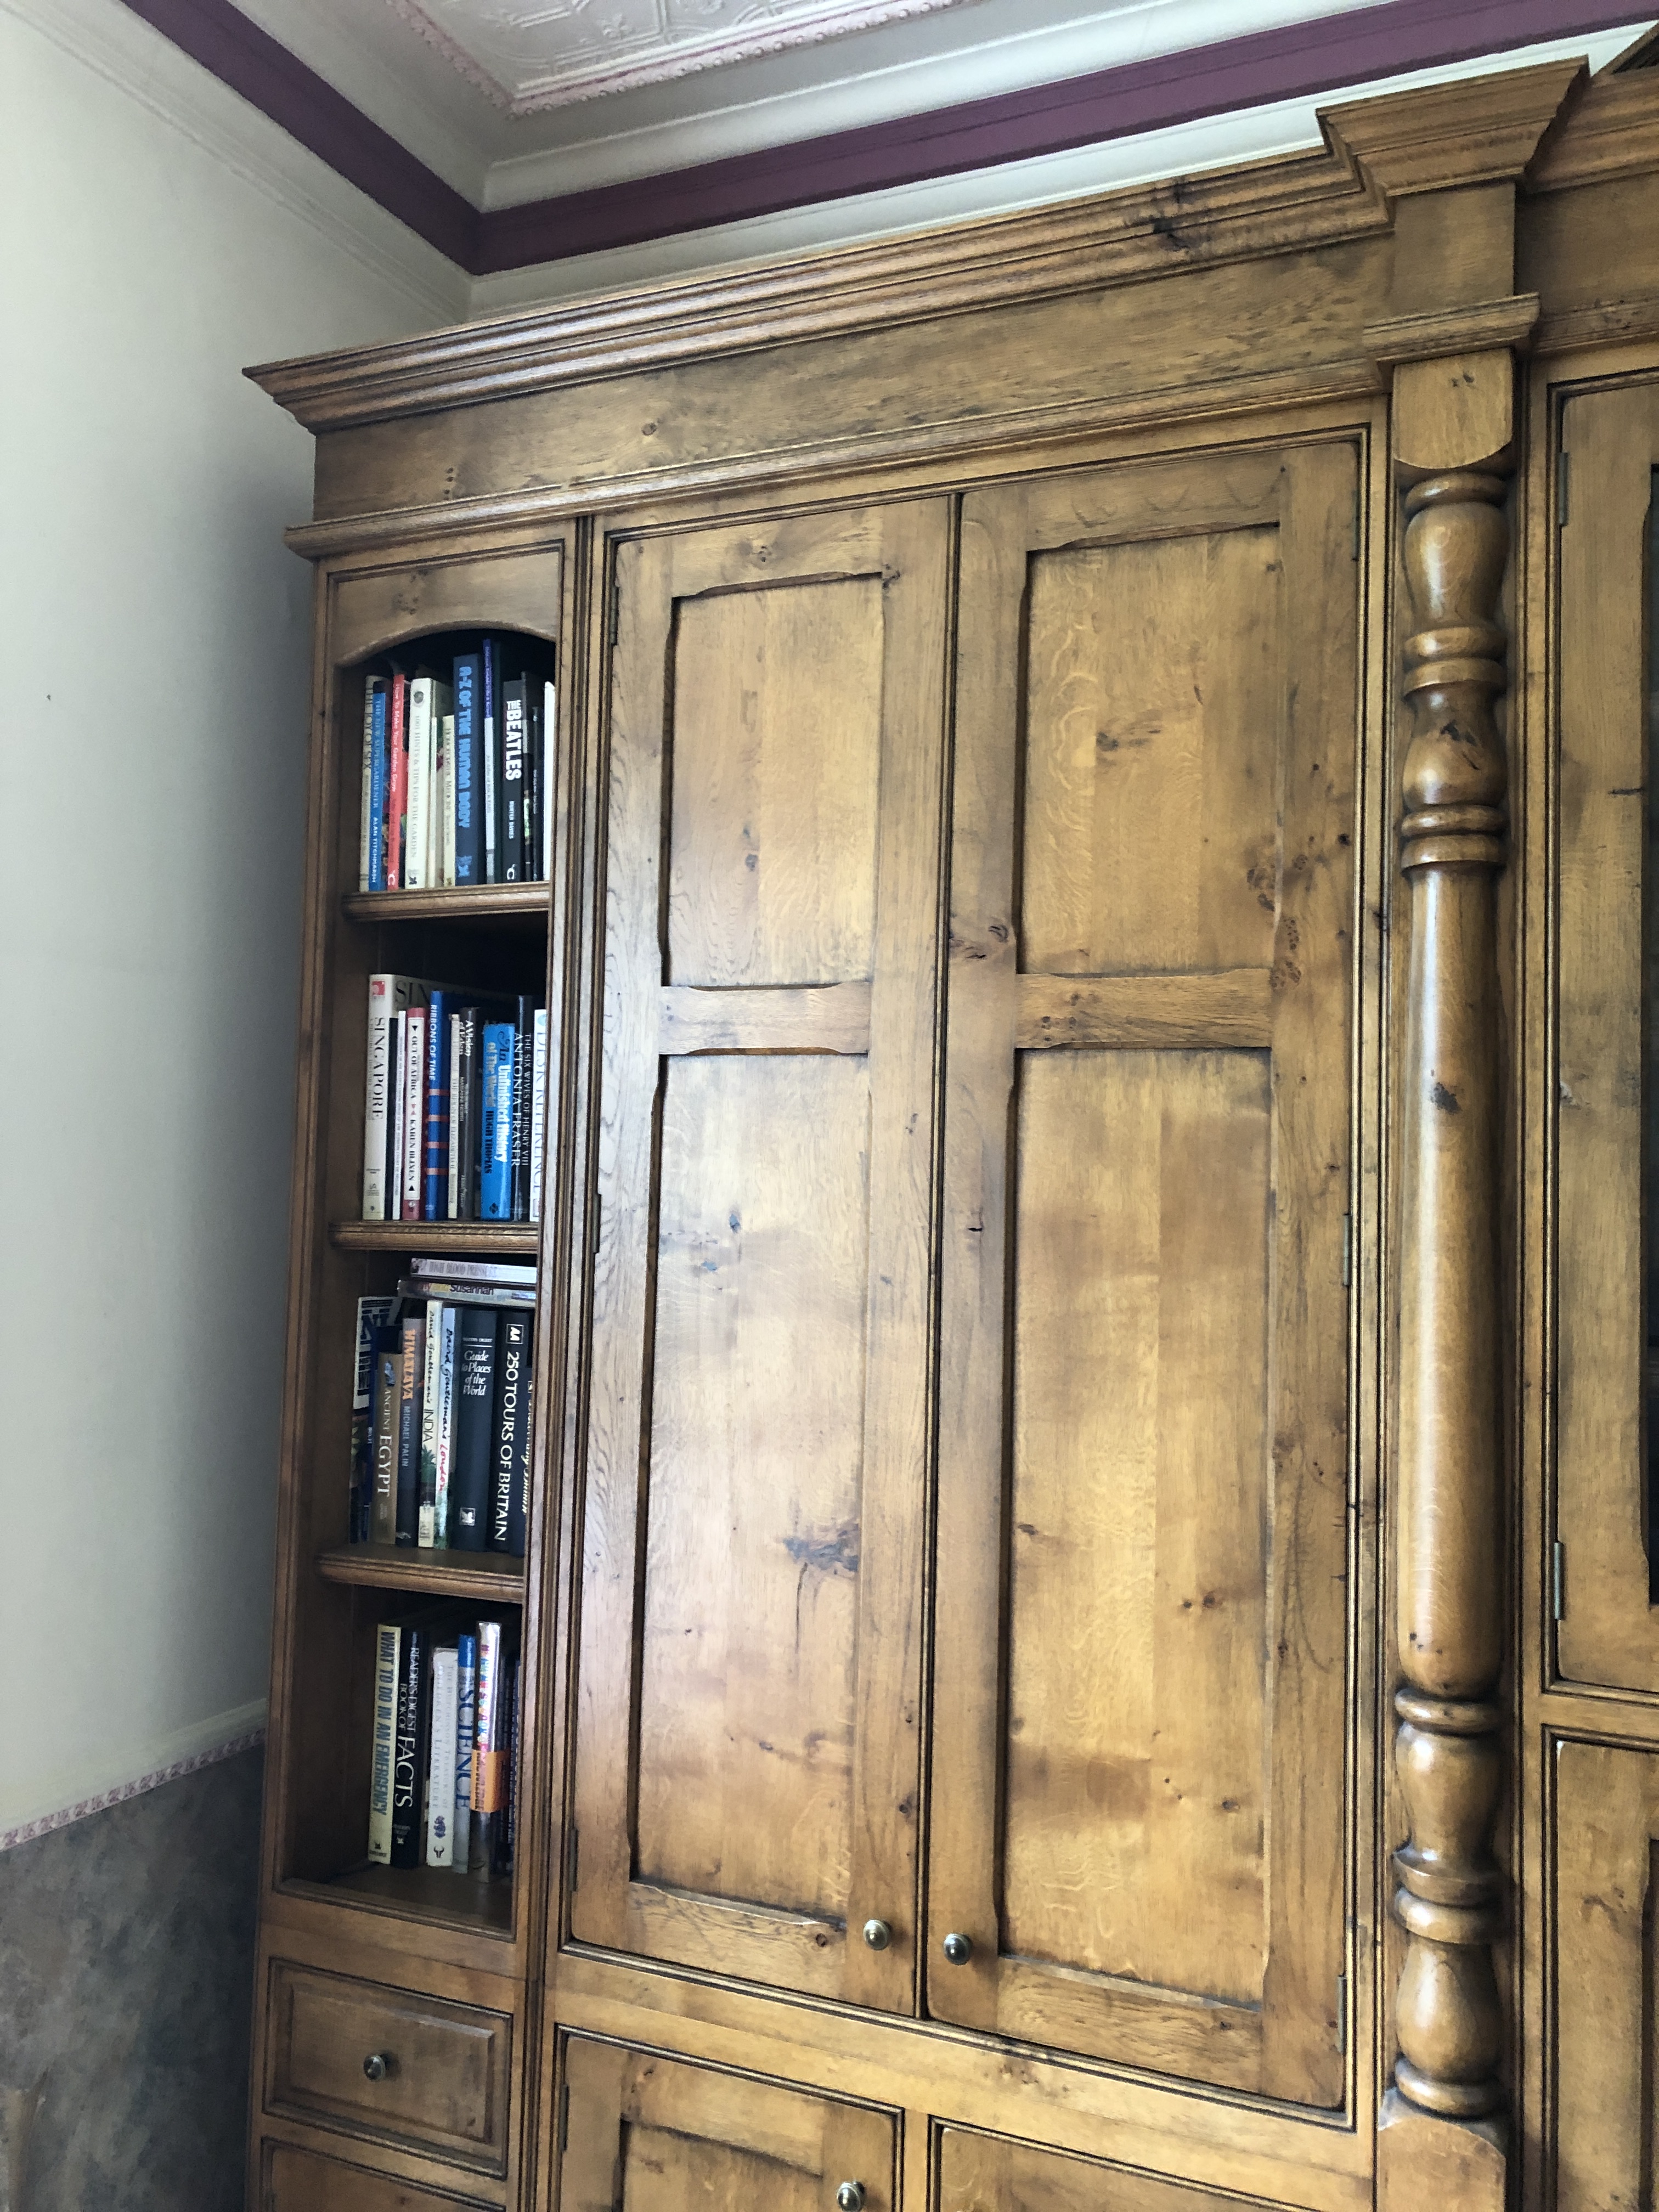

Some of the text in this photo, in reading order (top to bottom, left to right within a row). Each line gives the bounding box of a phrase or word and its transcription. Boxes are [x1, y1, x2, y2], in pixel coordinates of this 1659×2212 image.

[506, 700, 521, 709] THE
[458, 666, 472, 828] A-Z OF THE HUMAN BODY
[505, 709, 522, 781] BEATLES
[373, 1017, 386, 1120] SINGAPORE
[411, 1056, 417, 1065] OF
[430, 1045, 437, 1058] OF
[486, 1042, 498, 1053] of
[494, 1031, 511, 1163] An Unfinished History
[511, 1032, 523, 1166] ANTONIA FRASER
[523, 1102, 531, 1114] OF
[484, 1110, 494, 1174] HUGH THOMAS
[446, 1263, 466, 1276] BLOOD
[449, 1283, 494, 1296] Susannah
[444, 1328, 453, 1364] David
[464, 1350, 489, 1361] Guide
[510, 1327, 521, 1341] AA
[402, 1329, 416, 1400] HIMALAYA
[461, 1361, 492, 1373] to Places
[465, 1373, 486, 1386] of the
[383, 1390, 392, 1432] ANCIENT
[463, 1385, 487, 1396] World
[402, 1406, 411, 1467] MICHAEL PALIN
[423, 1409, 434, 1442] INDIA
[494, 1351, 520, 1541] 250 TOURS OF BRITAIN
[377, 1435, 393, 1497] EGYPT
[439, 1444, 448, 1492] London
[398, 1683, 408, 1732] BOOK OF
[407, 1647, 420, 1733] READER'S DIGEST
[373, 1632, 396, 1815] WHAT TO DO IN AN EMERGENCY
[395, 1735, 415, 1808] FACTS
[456, 1690, 474, 1809] SCIENCE
[432, 1740, 442, 1809] LITERATURE
